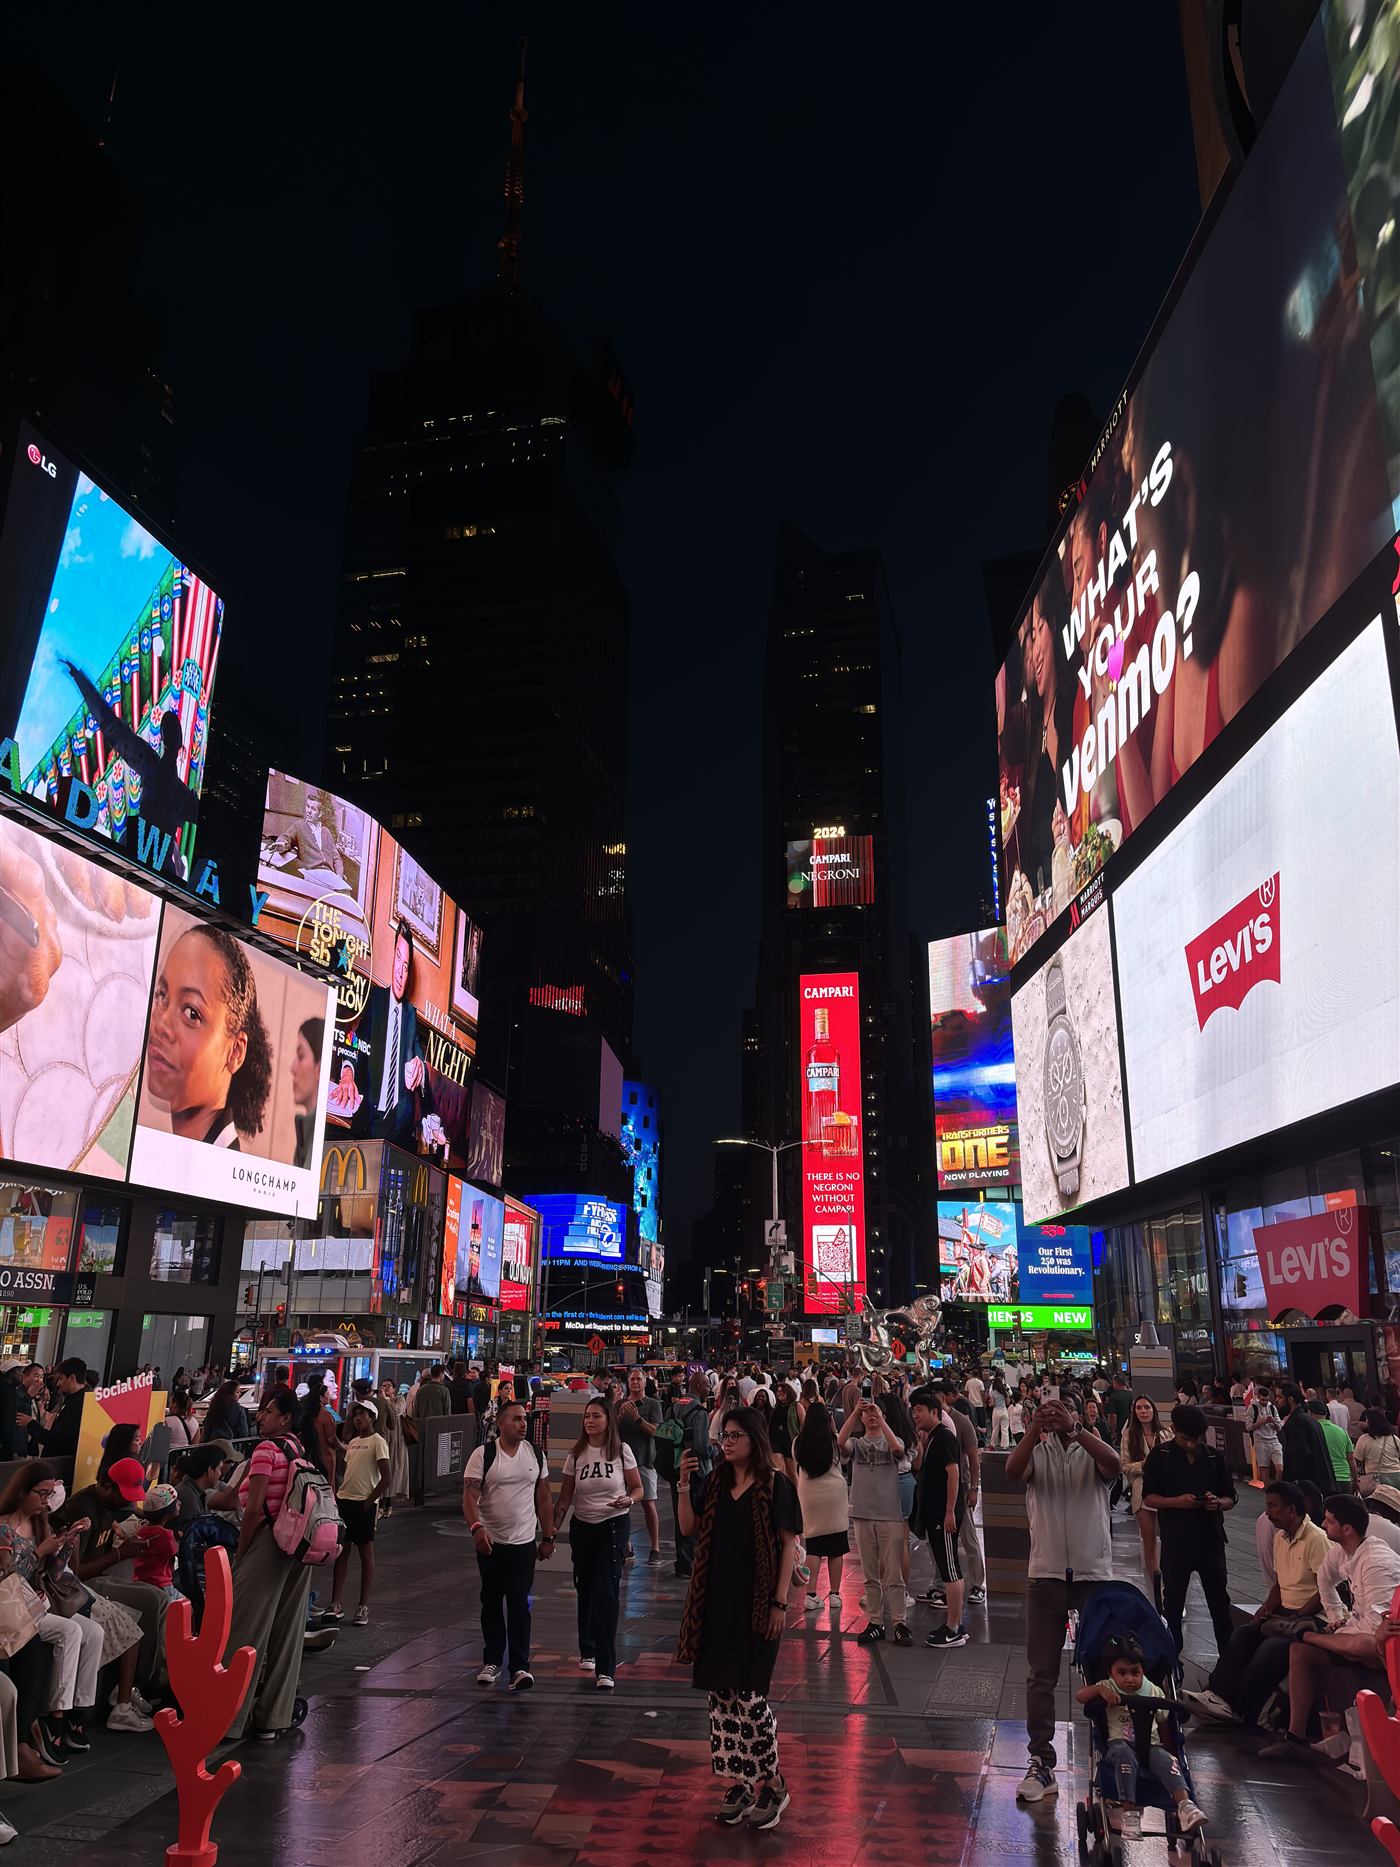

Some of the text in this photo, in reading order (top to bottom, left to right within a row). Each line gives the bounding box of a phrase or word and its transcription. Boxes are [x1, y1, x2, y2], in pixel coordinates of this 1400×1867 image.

[1091, 389, 1128, 472] MARRIOTT
[41, 455, 57, 478] LG
[1062, 440, 1174, 661] WHAT'S
[1078, 548, 1160, 701] YOUR
[1062, 570, 1200, 817] venmo?
[814, 826, 845, 839] 2024
[809, 853, 851, 865] CAMPARI
[801, 868, 860, 881] NEGRONI
[315, 902, 343, 930] THE
[804, 986, 854, 999] CAMPARI
[424, 1000, 456, 1040] WHAT A
[358, 1039, 371, 1056] NBC
[424, 1029, 471, 1088] NIGHT
[806, 1067, 840, 1078] CAMPARI
[941, 1125, 1010, 1140] TRANSFORMERS
[941, 1135, 1010, 1171] ONE
[232, 1167, 296, 1192] LONGCHAMP
[806, 1172, 860, 1180] THERE IS NO
[944, 1169, 1009, 1181] NOW PLAYING
[813, 1183, 853, 1191] NEGRONI
[812, 1194, 855, 1202] WITHOUT
[815, 1205, 855, 1214] CAMPARI
[1038, 1247, 1073, 1256] Our First
[1041, 1257, 1072, 1266] 250 was
[1028, 1265, 1085, 1277] Revolutionary.
[13, 1271, 56, 1291] ASSN.
[1054, 1312, 1087, 1324] NEW
[848, 1323, 860, 1331] 25
[94, 1370, 154, 1401] Social Kid
[580, 1462, 614, 1480] GAP
